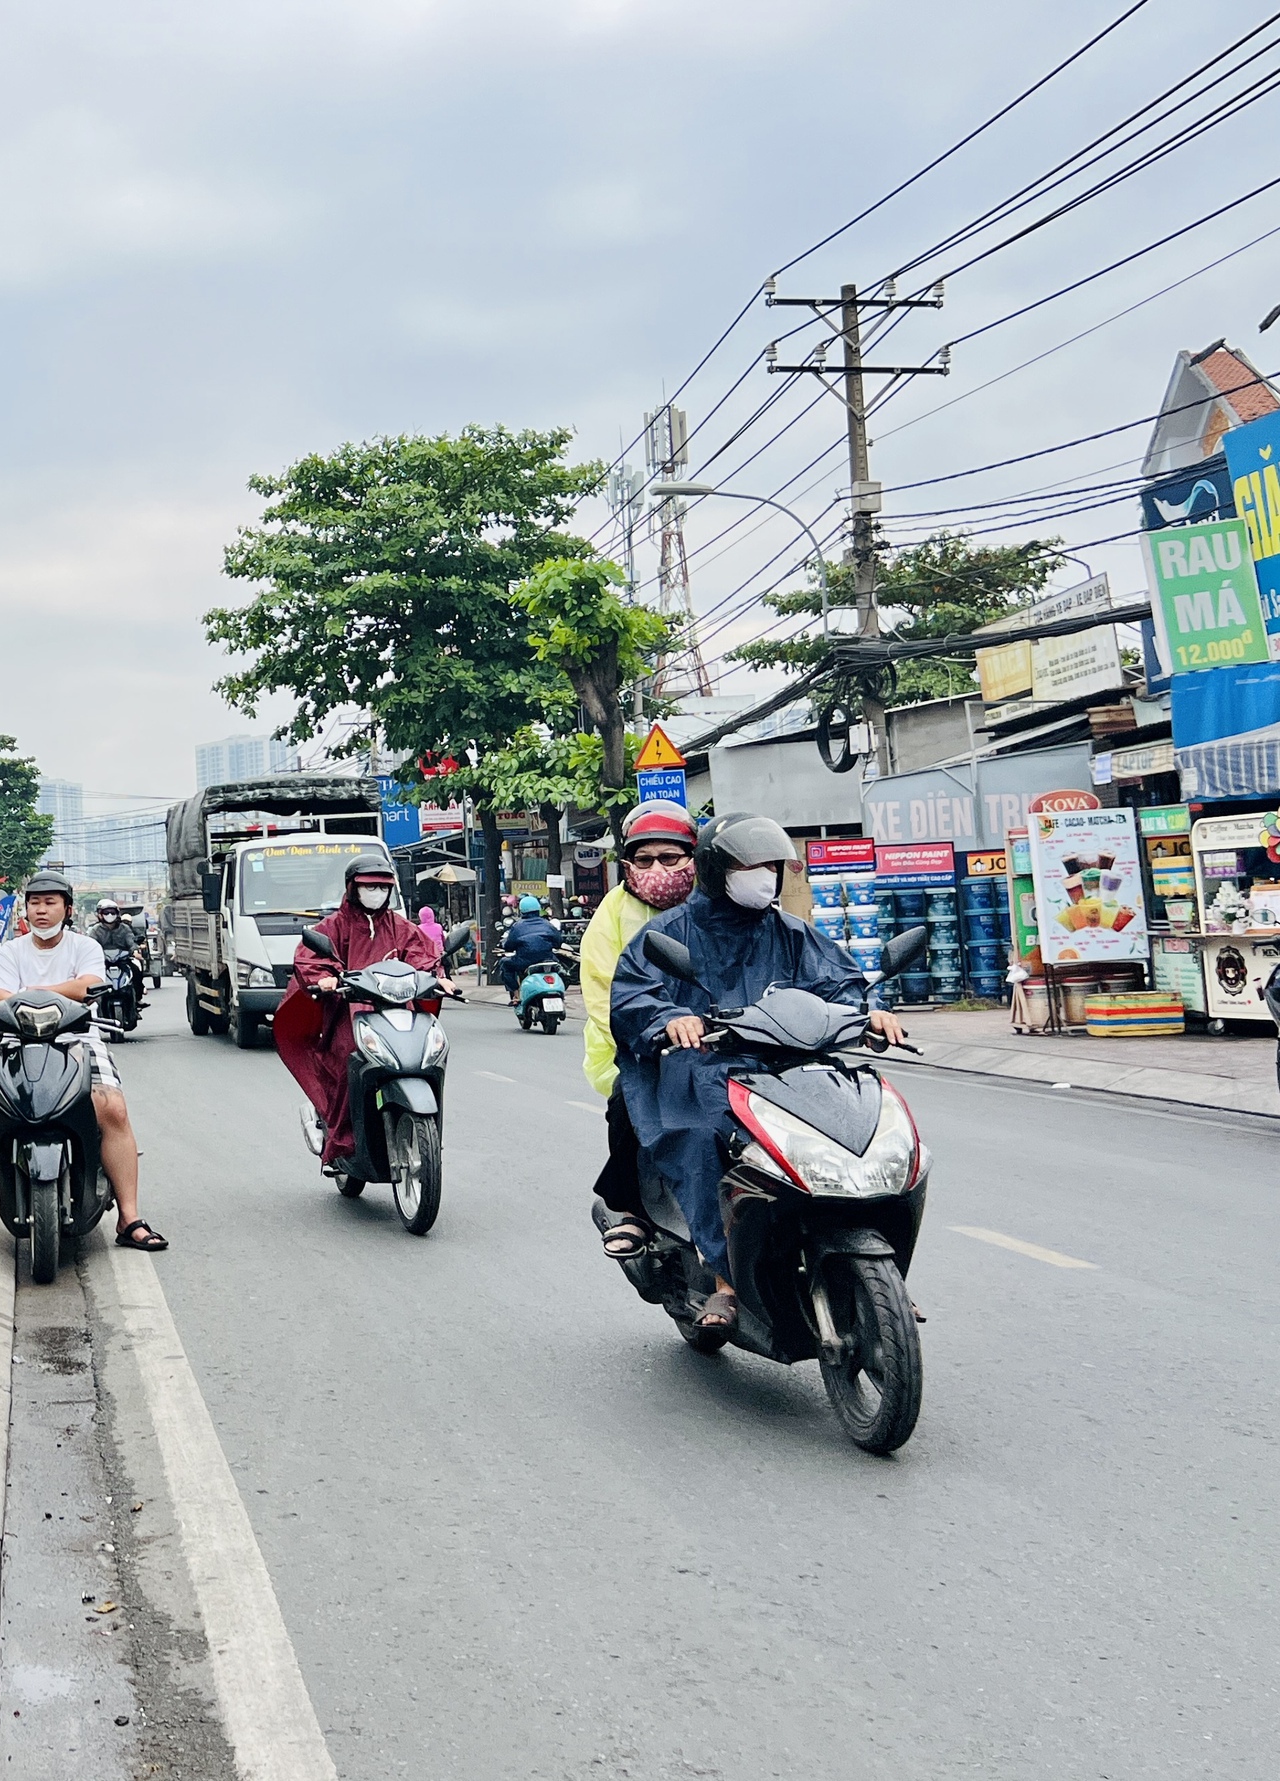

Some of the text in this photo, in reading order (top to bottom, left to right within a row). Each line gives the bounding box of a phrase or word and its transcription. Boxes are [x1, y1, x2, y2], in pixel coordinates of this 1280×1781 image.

[1157, 530, 1243, 580] RAU
[1172, 580, 1247, 634] MÁ
[665, 775, 682, 785] CAO
[644, 787, 680, 800] AN TOÀN
[1041, 798, 1090, 813] KOVA
[869, 801, 903, 841] XE
[884, 849, 950, 861] NIPPON PAINT
